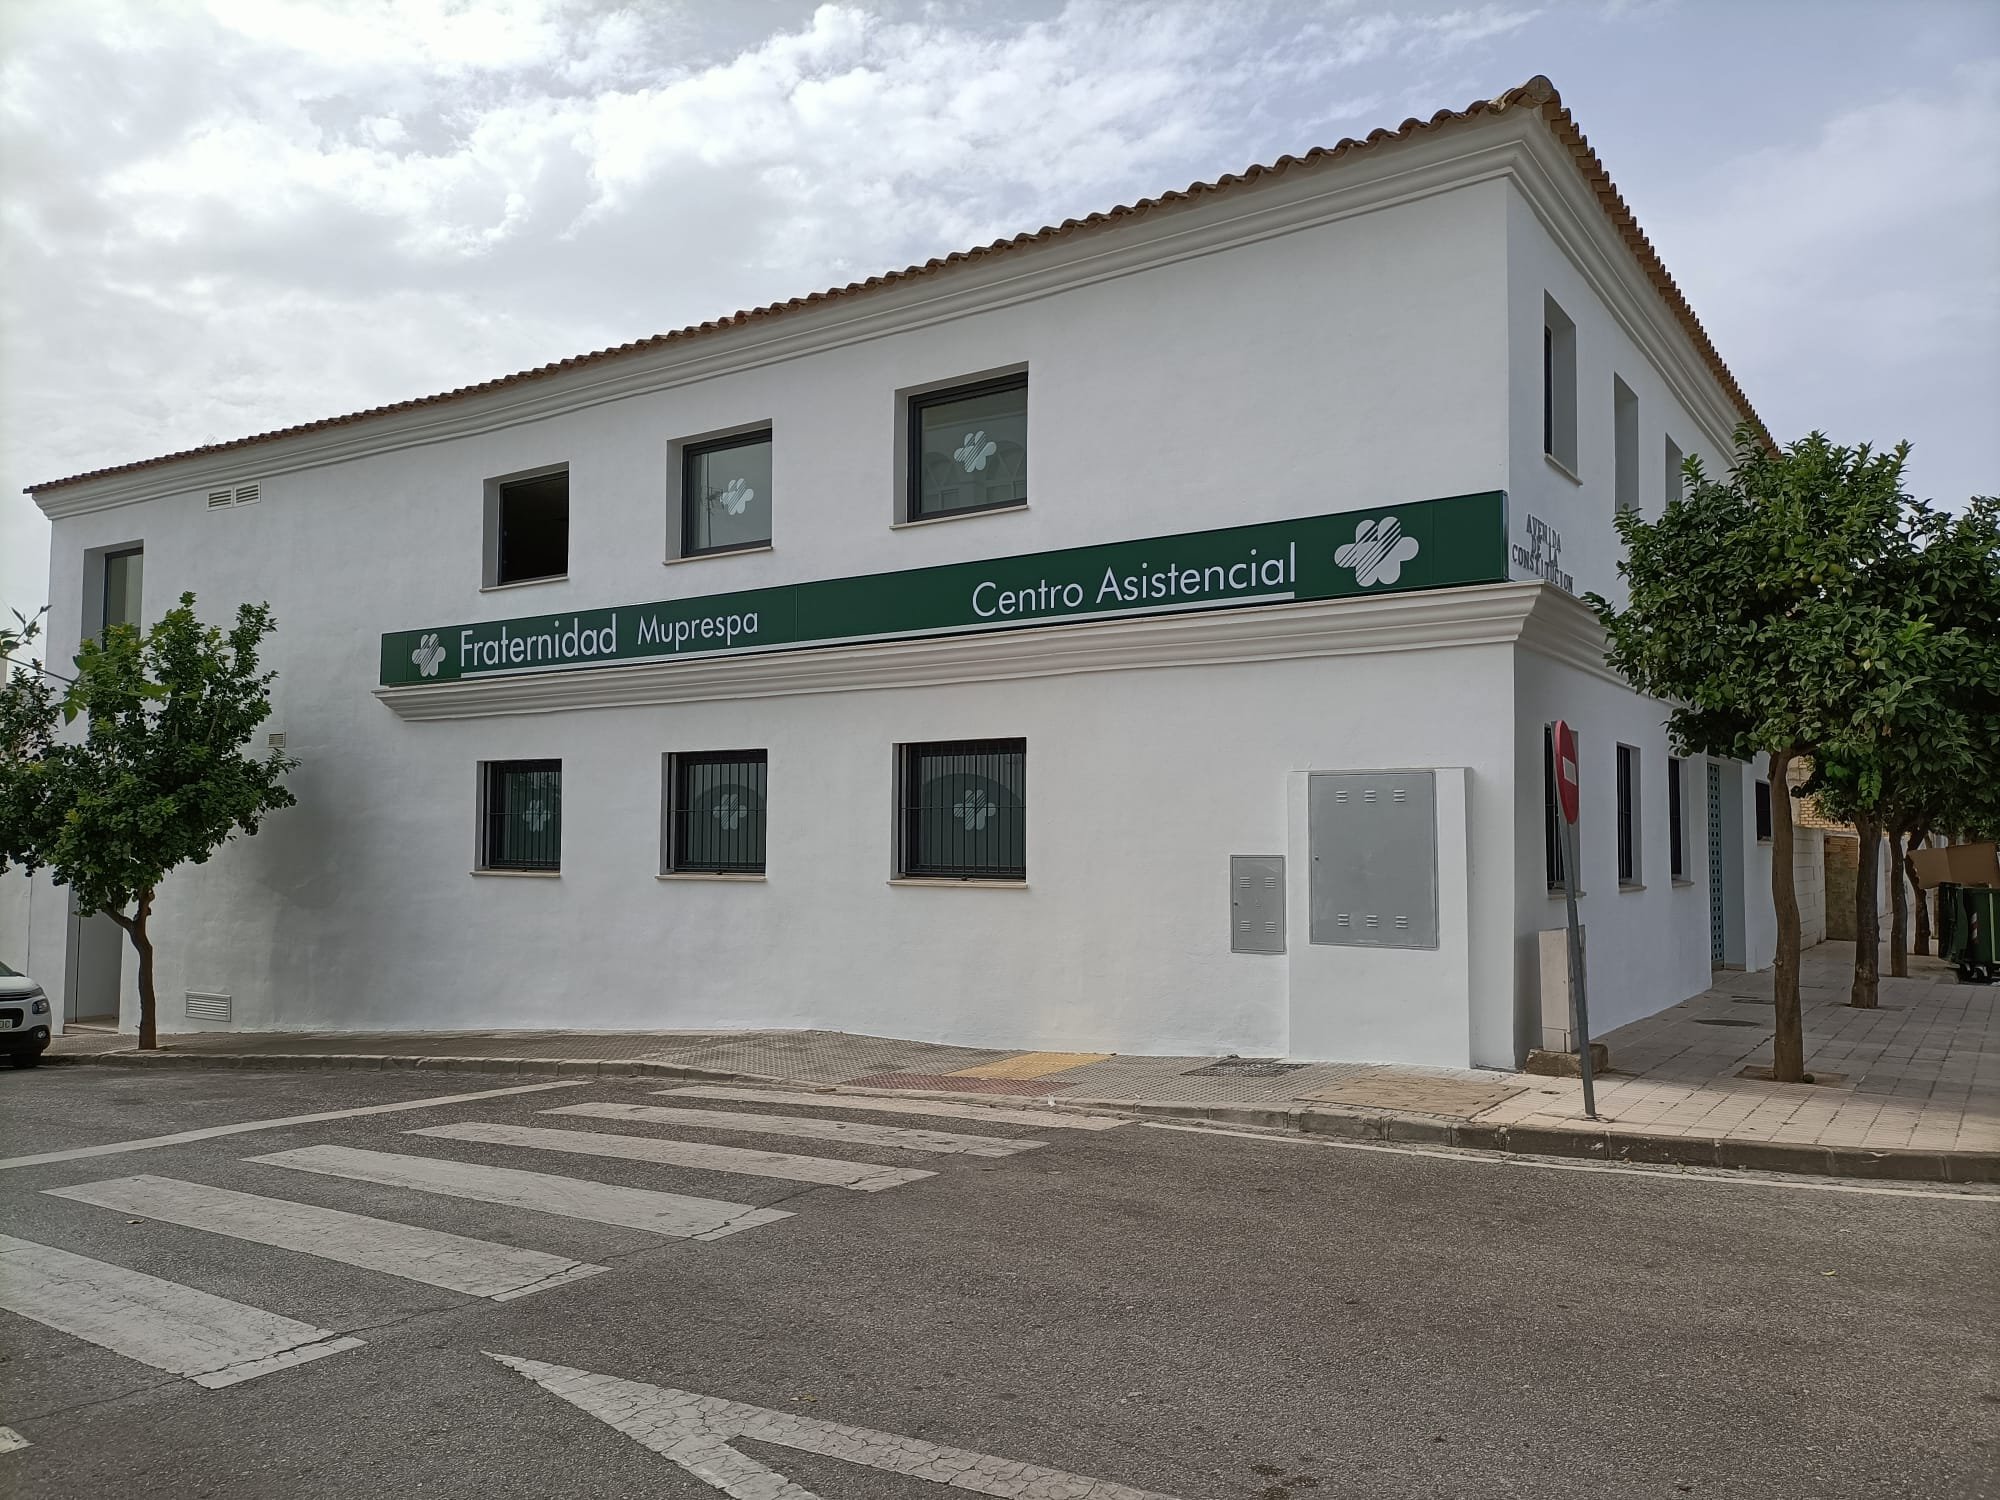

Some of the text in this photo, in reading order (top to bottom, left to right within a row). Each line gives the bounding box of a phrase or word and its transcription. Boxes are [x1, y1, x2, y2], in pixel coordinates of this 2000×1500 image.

[1526, 513, 1561, 552] AVENIDA
[972, 541, 1296, 617] Centro Asistencial
[460, 611, 759, 667] Fraternidad Muprespa
